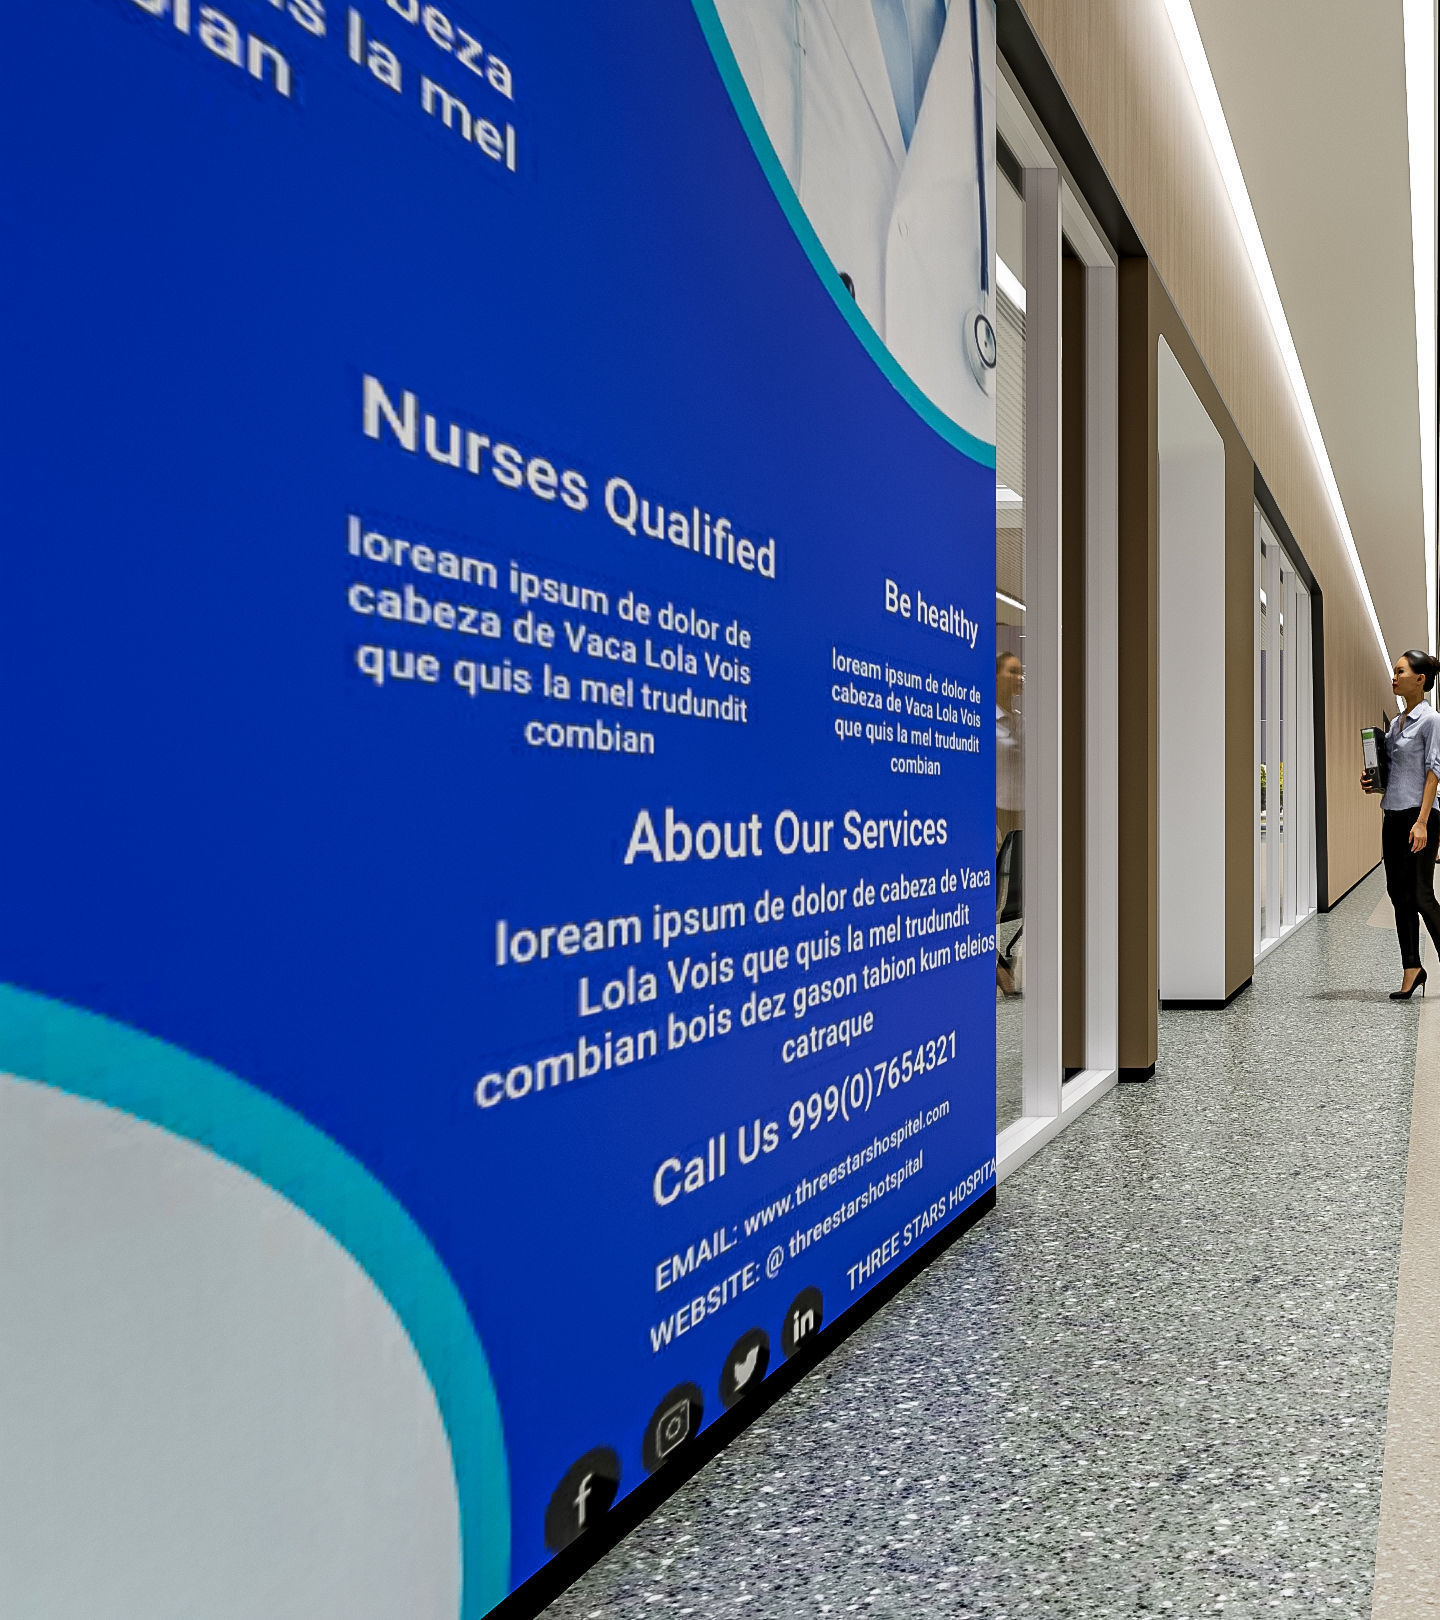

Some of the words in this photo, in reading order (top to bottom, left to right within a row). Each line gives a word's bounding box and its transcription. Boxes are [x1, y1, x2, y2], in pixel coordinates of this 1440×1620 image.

[348, 6, 403, 94] la
[421, 74, 517, 173] mel
[363, 375, 589, 511] Nurses
[604, 477, 776, 579] Qualified
[348, 584, 501, 638] cabeza
[513, 610, 555, 648] de
[563, 621, 637, 664] Vaca
[645, 639, 698, 675] Lola
[704, 651, 751, 685] Vois
[510, 561, 609, 615] ipsum
[617, 591, 651, 625] de
[657, 602, 720, 641] dolor
[725, 619, 751, 649] de
[885, 578, 912, 618] Be
[917, 590, 979, 649] healthy
[357, 645, 440, 686] que
[453, 660, 532, 697] quis
[543, 663, 571, 700] la
[581, 678, 634, 708] mel
[640, 684, 748, 723] trudundit
[831, 681, 883, 710] cabeza
[886, 691, 902, 713] de
[904, 695, 934, 719] Vaca
[936, 702, 958, 724] Lola
[960, 707, 981, 728] Vois
[885, 662, 923, 690] ipsum
[925, 673, 939, 694] de
[941, 677, 968, 701] dolor
[969, 685, 981, 704] de
[524, 719, 655, 754] combian
[834, 718, 862, 741] que
[865, 723, 894, 745] quis
[897, 722, 908, 744] la
[910, 727, 932, 747] mel
[934, 730, 980, 753] trudundit
[890, 754, 941, 776] combian
[623, 807, 763, 865] About
[774, 809, 835, 855] Our
[843, 809, 948, 851] Services
[653, 902, 746, 948] ipsum
[754, 889, 785, 924] de
[791, 882, 848, 918] dolor
[852, 878, 876, 908] de
[879, 873, 937, 903] cabeza
[940, 868, 958, 894] de
[960, 867, 991, 890] Vaca
[579, 966, 657, 1017] Lola
[667, 951, 734, 994] Vois
[742, 945, 790, 984] que
[795, 929, 842, 971] quis
[847, 923, 864, 953] la
[869, 914, 901, 948] mel
[905, 902, 970, 939] trudundit
[475, 1029, 657, 1108] combian
[667, 1003, 732, 1050] bois
[740, 991, 786, 1027] dez
[793, 973, 857, 1019] gason
[862, 956, 916, 990] tabion
[920, 946, 951, 973] kum
[953, 934, 995, 962] teleios
[781, 1011, 874, 1064] catraque
[653, 1132, 726, 1207] Call
[738, 1118, 779, 1165] Us
[788, 1030, 956, 1140] 999(0)7654321
[650, 1262, 760, 1352] WEBSITE:
[765, 1245, 785, 1279] @
[788, 1149, 923, 1258] threestarshotspital
[656, 1227, 738, 1292] EMAIL:
[846, 1231, 900, 1291] THREE
[903, 1196, 946, 1247] STARS
